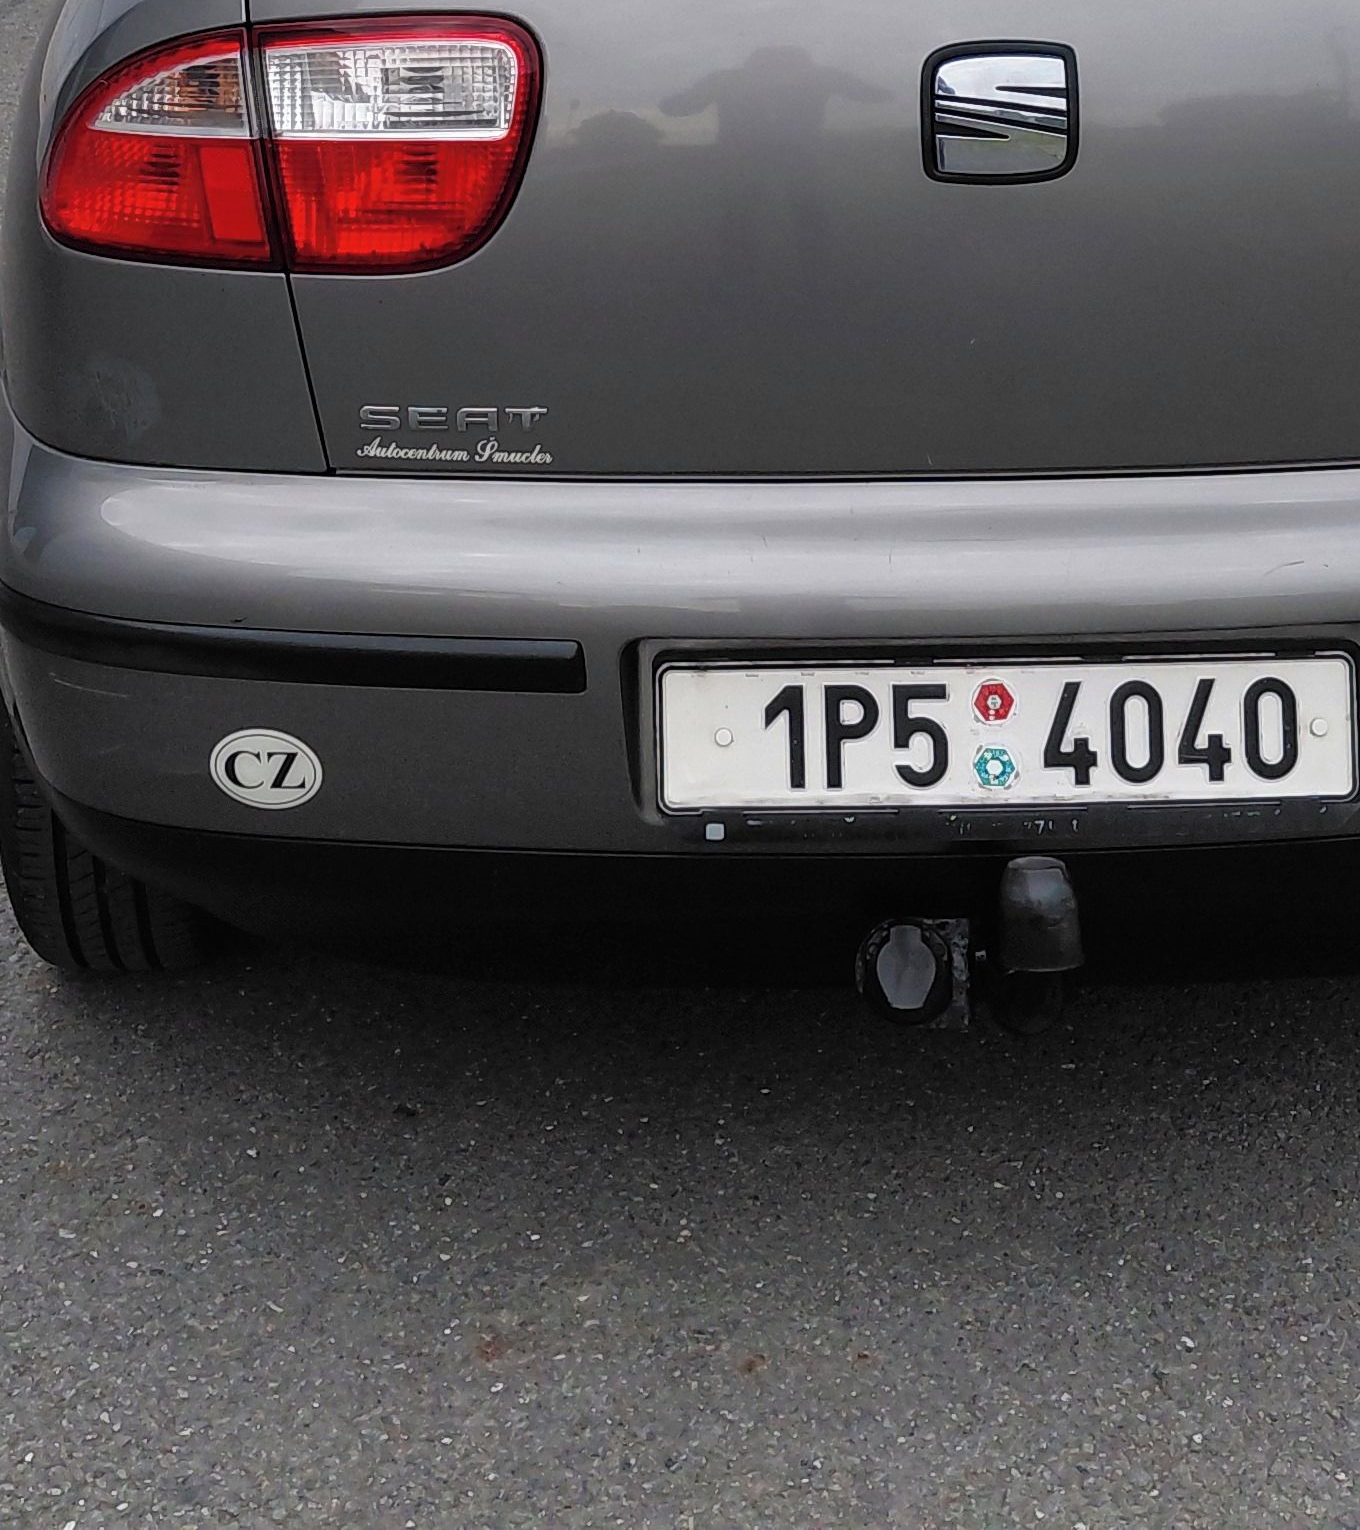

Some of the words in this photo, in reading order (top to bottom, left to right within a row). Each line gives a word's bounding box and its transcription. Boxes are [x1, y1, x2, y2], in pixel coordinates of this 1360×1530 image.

[359, 405, 548, 432] SEAT
[356, 436, 470, 462] Autocentrum
[474, 436, 554, 464] Šmucler
[763, 682, 950, 790] 1P5
[1043, 676, 1300, 787] 4040
[224, 750, 306, 789] CZ
